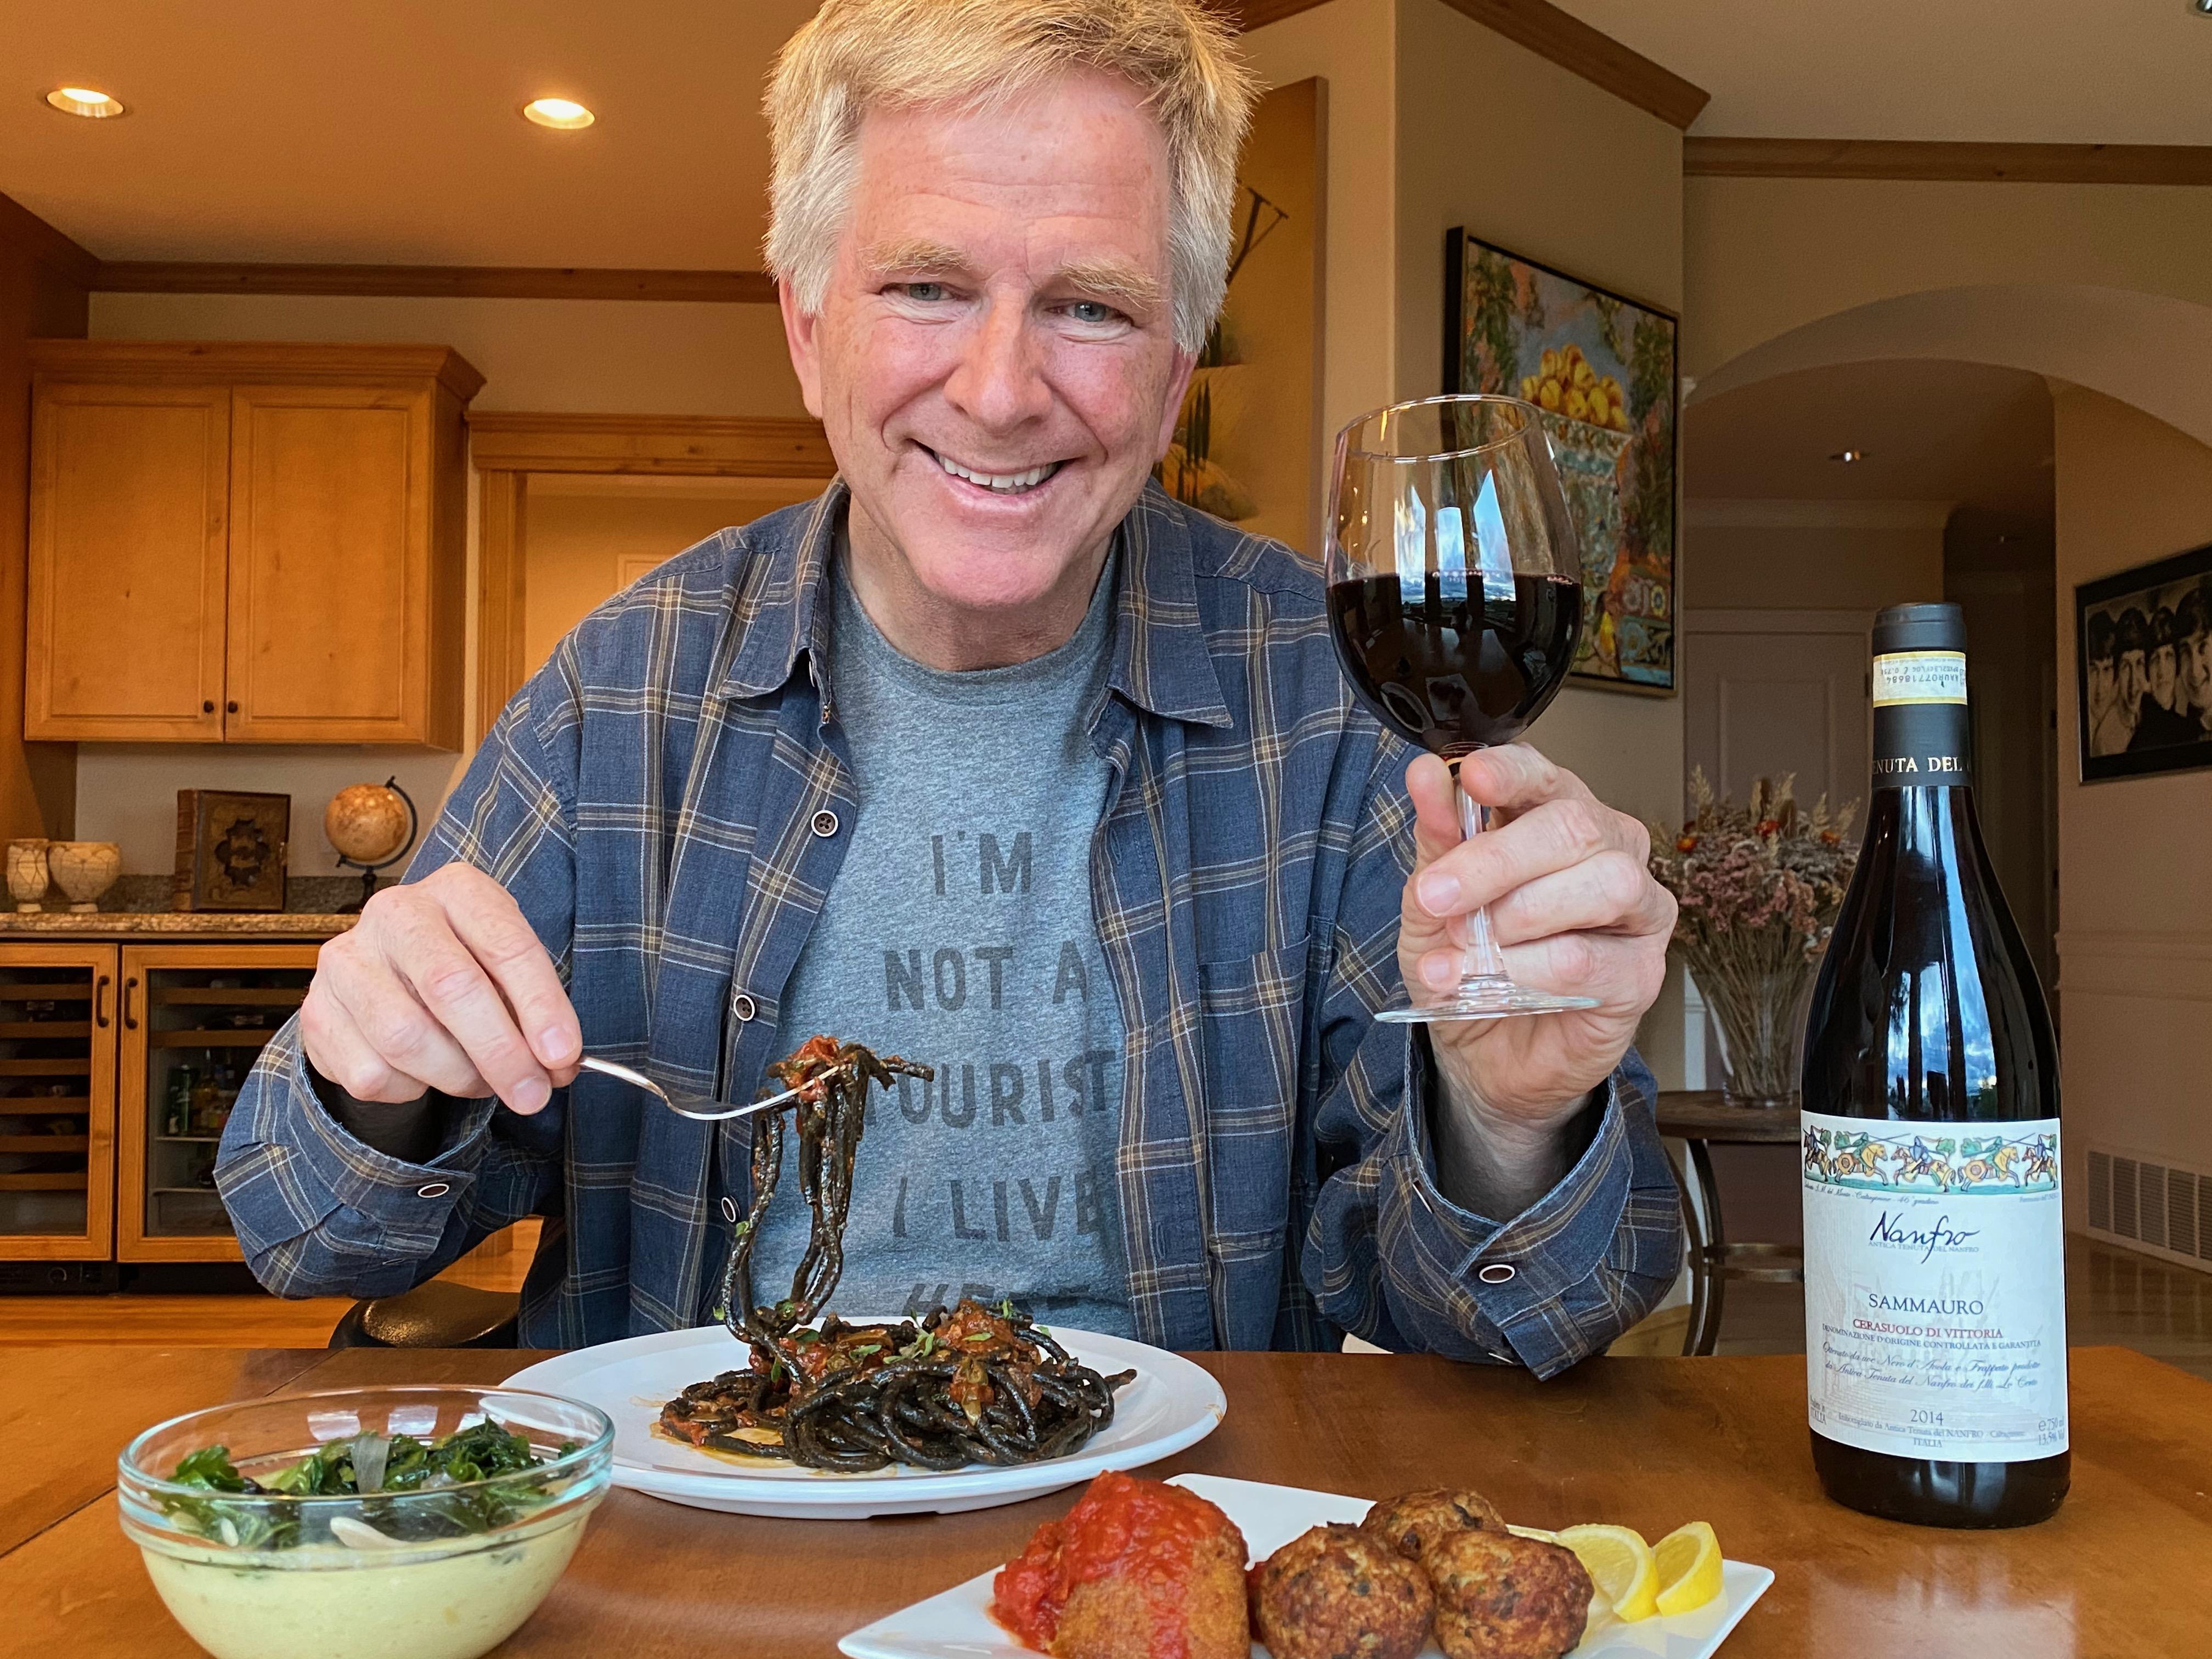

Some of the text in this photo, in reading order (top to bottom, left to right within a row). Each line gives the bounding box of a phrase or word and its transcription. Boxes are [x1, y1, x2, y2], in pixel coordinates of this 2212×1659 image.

[1927, 757, 1962, 772] DEL
[930, 831, 1033, 896] I'M
[883, 940, 1088, 1012] NOT A
[950, 1170, 1099, 1243] LIVE
[1867, 1240, 1897, 1250] ANTICA
[1897, 1243, 1930, 1252] TENUTA
[1869, 1210, 1980, 1264] Nanfro
[1868, 1293, 1984, 1315] SAMMAURO
[1822, 1323, 2041, 1350] DENOMINAZIONE D'ORIGINE CONTROLLATA E GARANTITA
[1853, 1318, 2004, 1339] CERASUOLO DI VITTORIA
[1877, 1355, 1906, 1368] Nero
[1833, 1363, 1863, 1377] Antica
[1864, 1368, 1897, 1384] Tenuta
[1898, 1375, 1914, 1386] del
[1915, 1375, 1957, 1390] Nanfro
[1910, 1408, 1944, 1426] 2014
[1875, 1420, 1883, 1430] da
[1946, 1428, 1984, 1438] NANFRO
[1912, 1437, 1943, 1448] ITALIA
